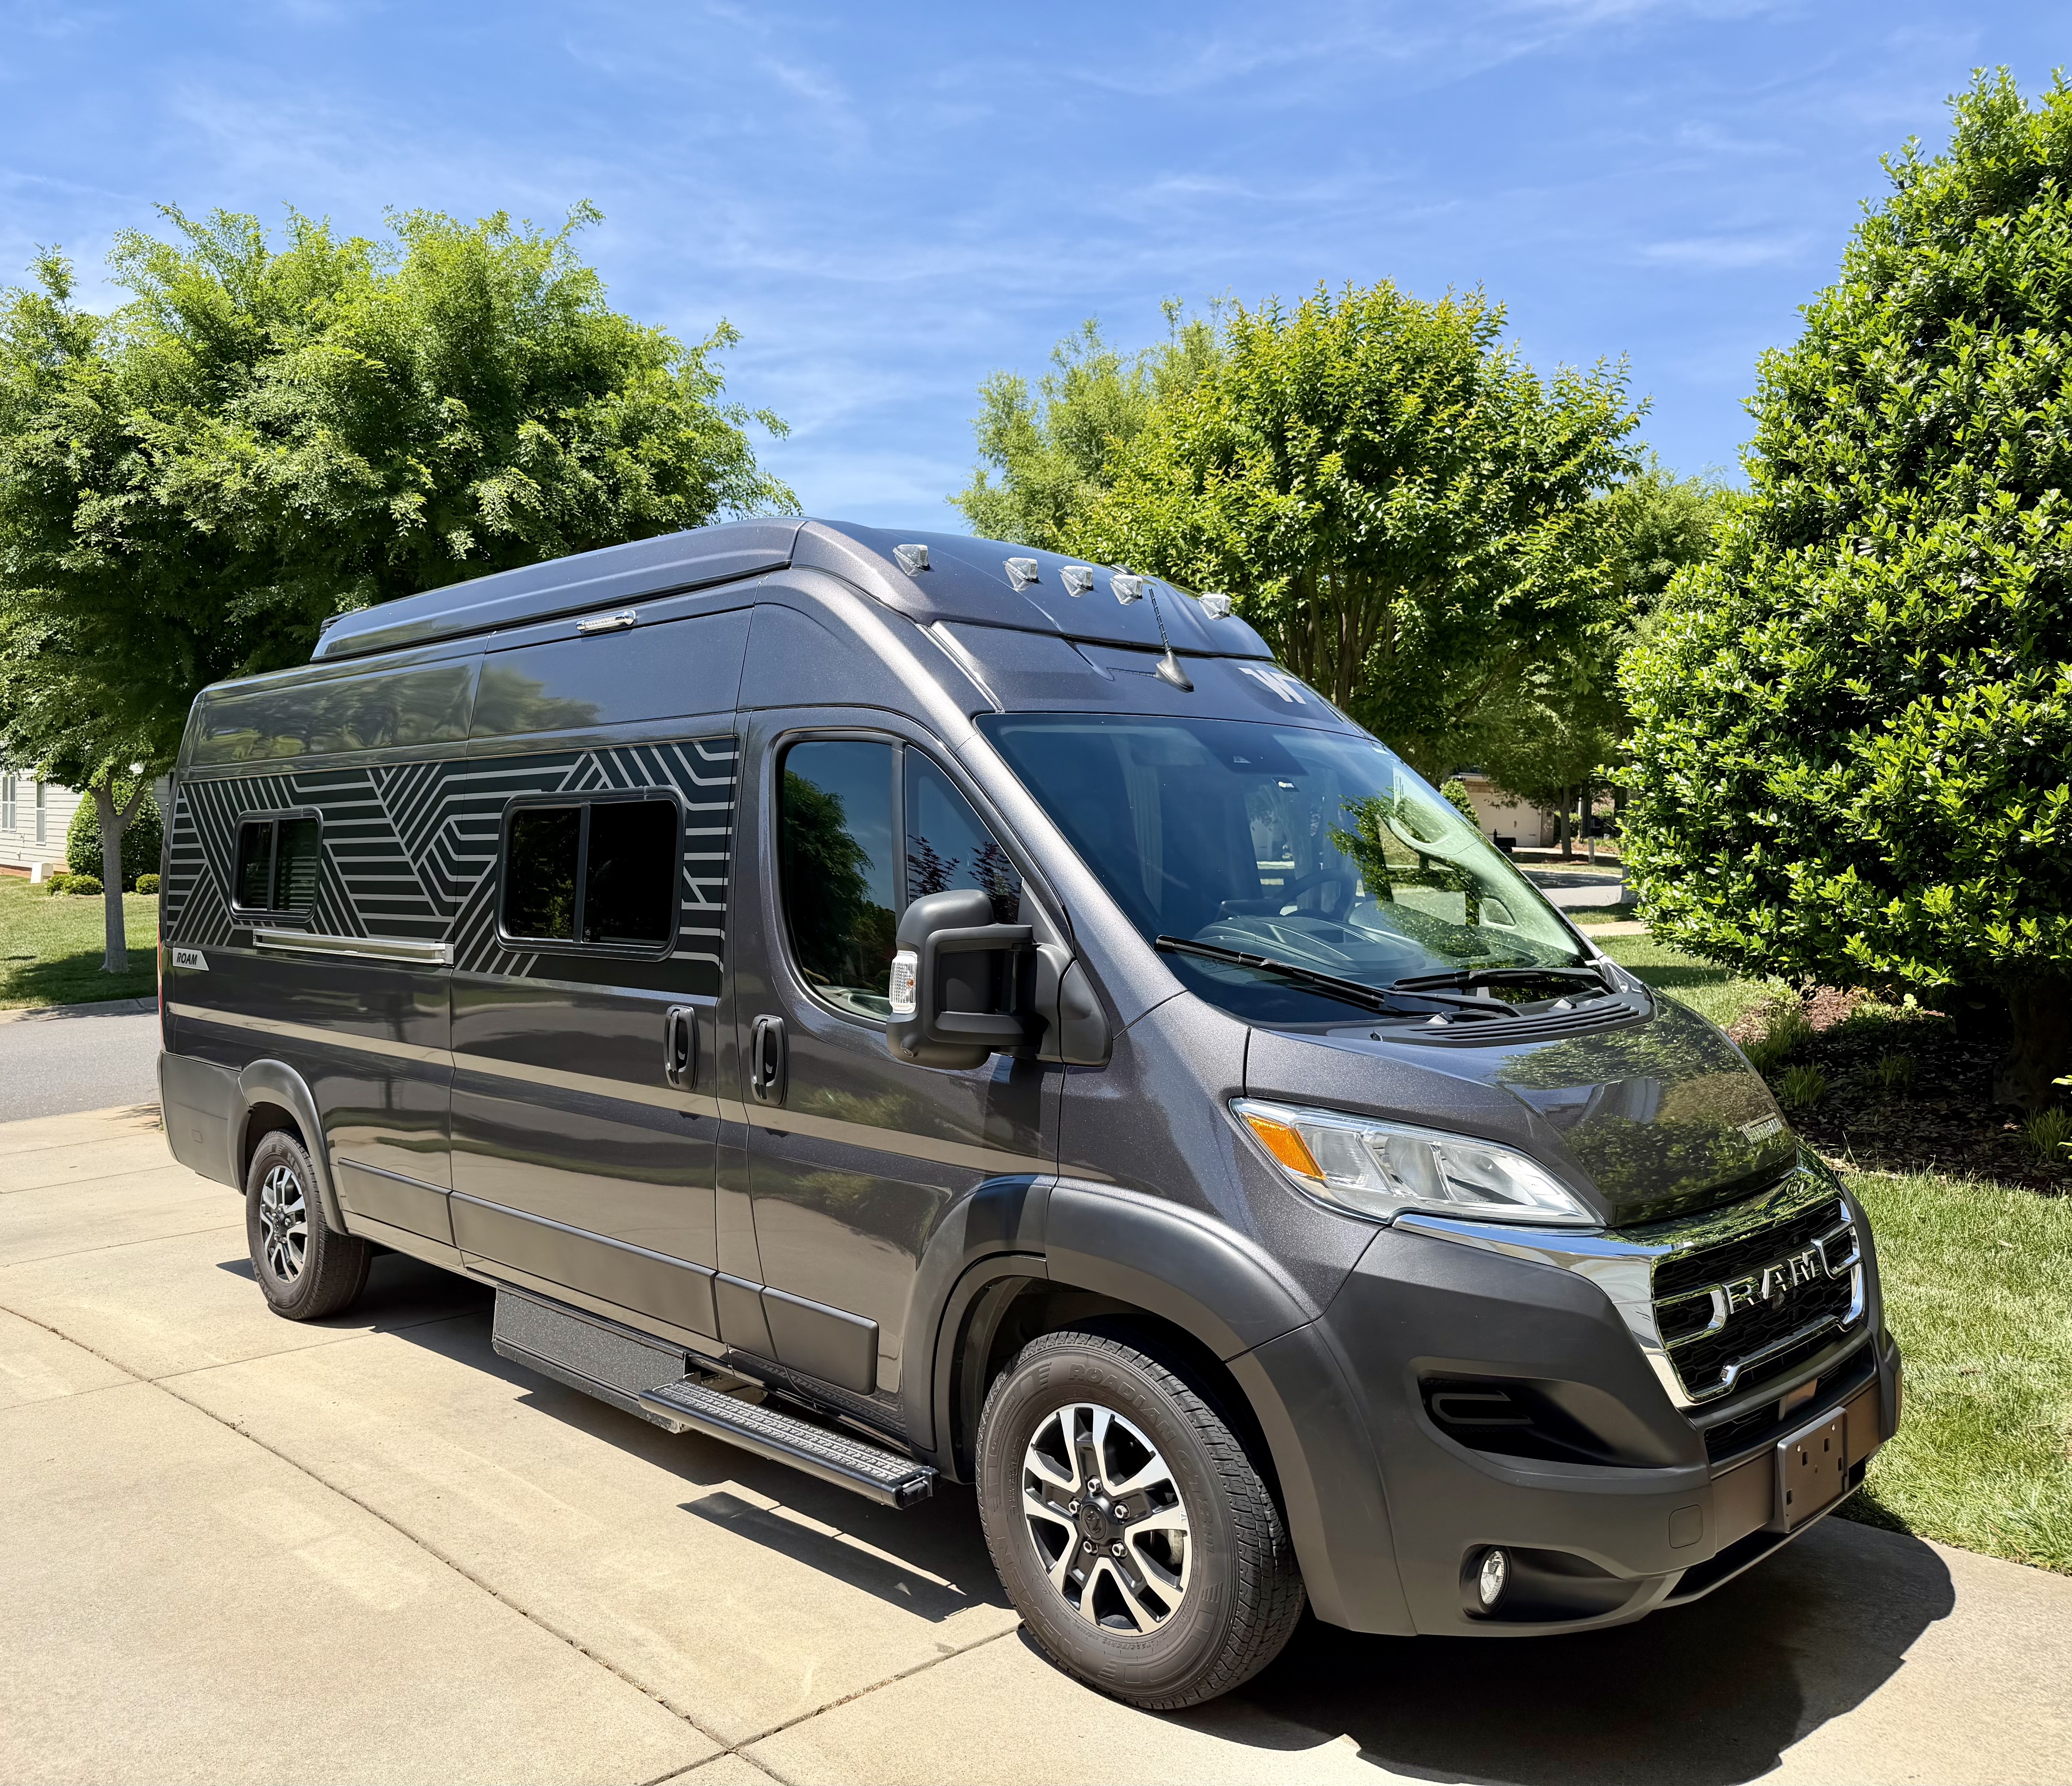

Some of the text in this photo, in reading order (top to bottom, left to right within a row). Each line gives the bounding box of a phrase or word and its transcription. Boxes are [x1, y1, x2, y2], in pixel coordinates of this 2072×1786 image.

[176, 952, 198, 965] ROAM
[1723, 1248, 1821, 1314] RAM
[1069, 1363, 1176, 1443] ROADIAN
[996, 1536, 1083, 1665] NEXEN
